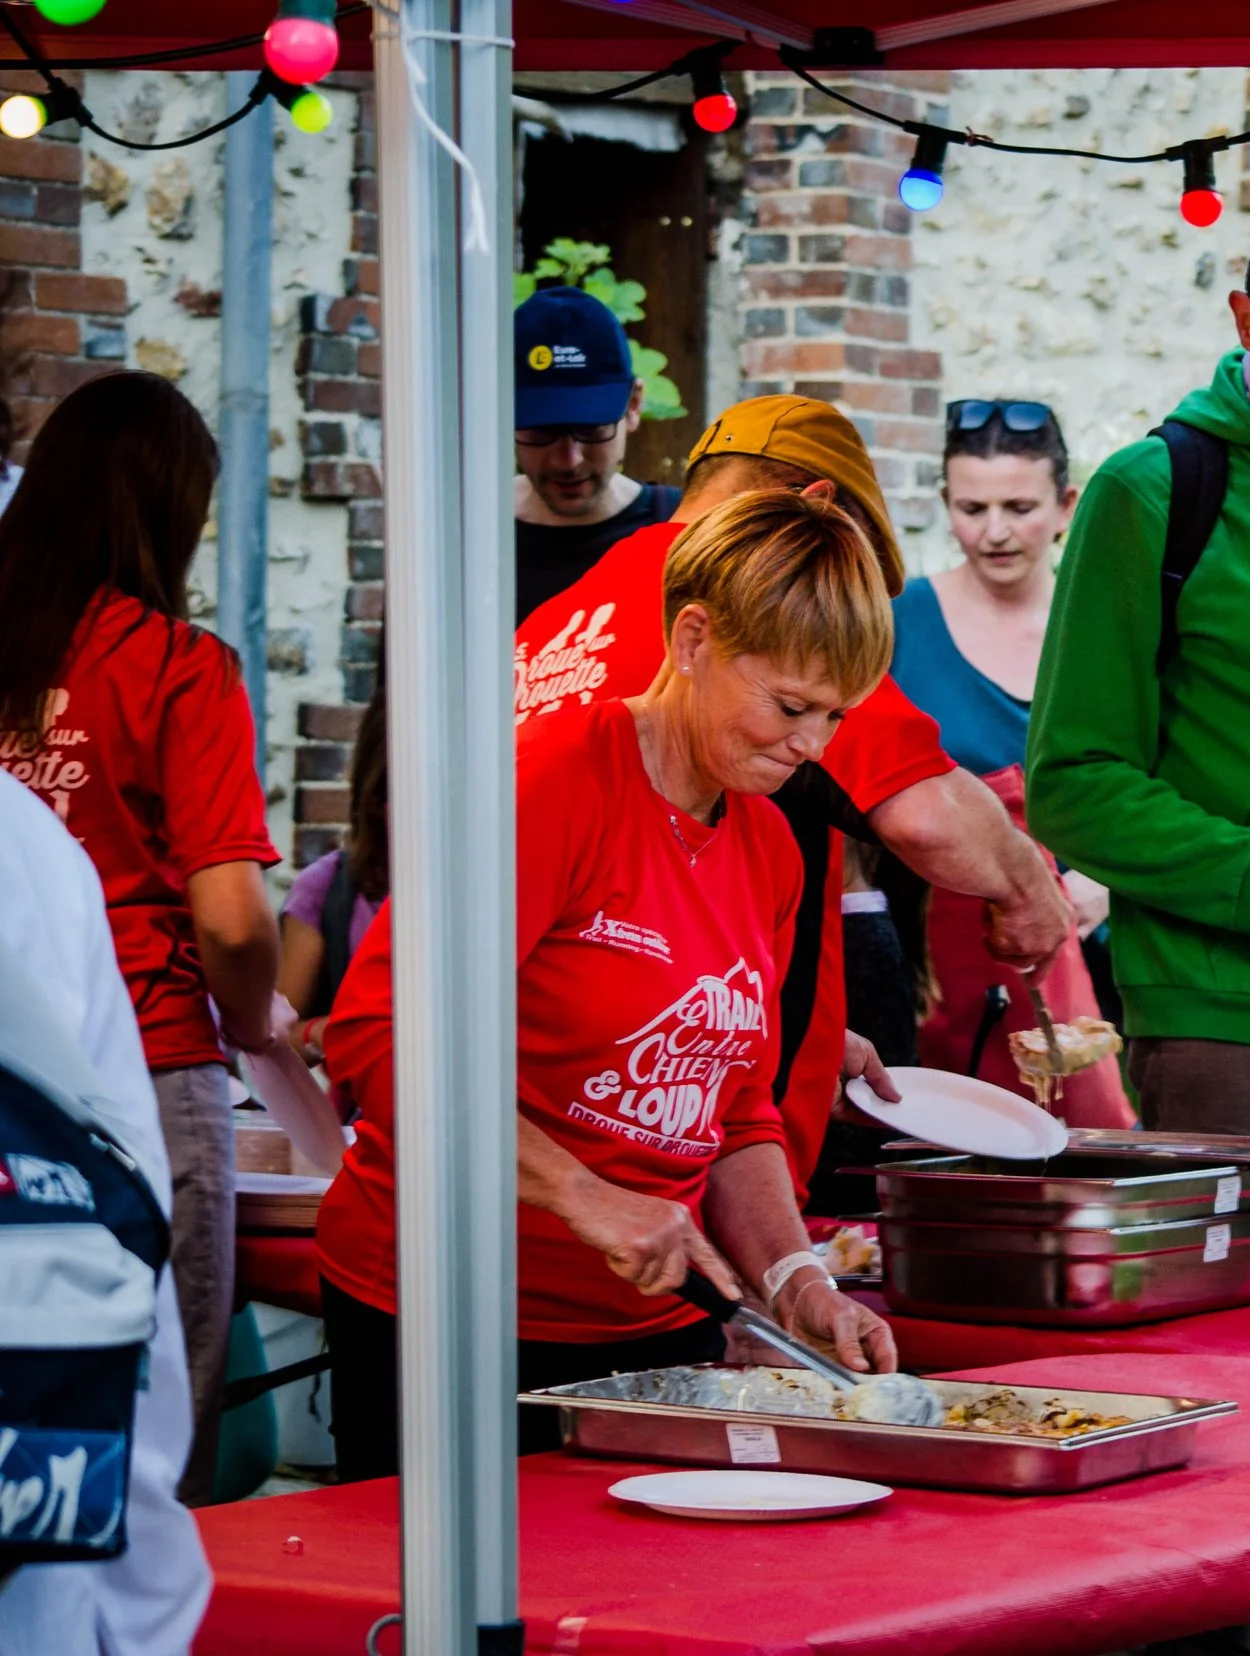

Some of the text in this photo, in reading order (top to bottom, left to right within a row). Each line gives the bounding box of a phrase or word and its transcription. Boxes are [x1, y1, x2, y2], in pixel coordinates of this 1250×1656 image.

[46, 729, 90, 746] sur
[702, 980, 761, 1031] TRAIL
[584, 1070, 703, 1138] & LOUP
